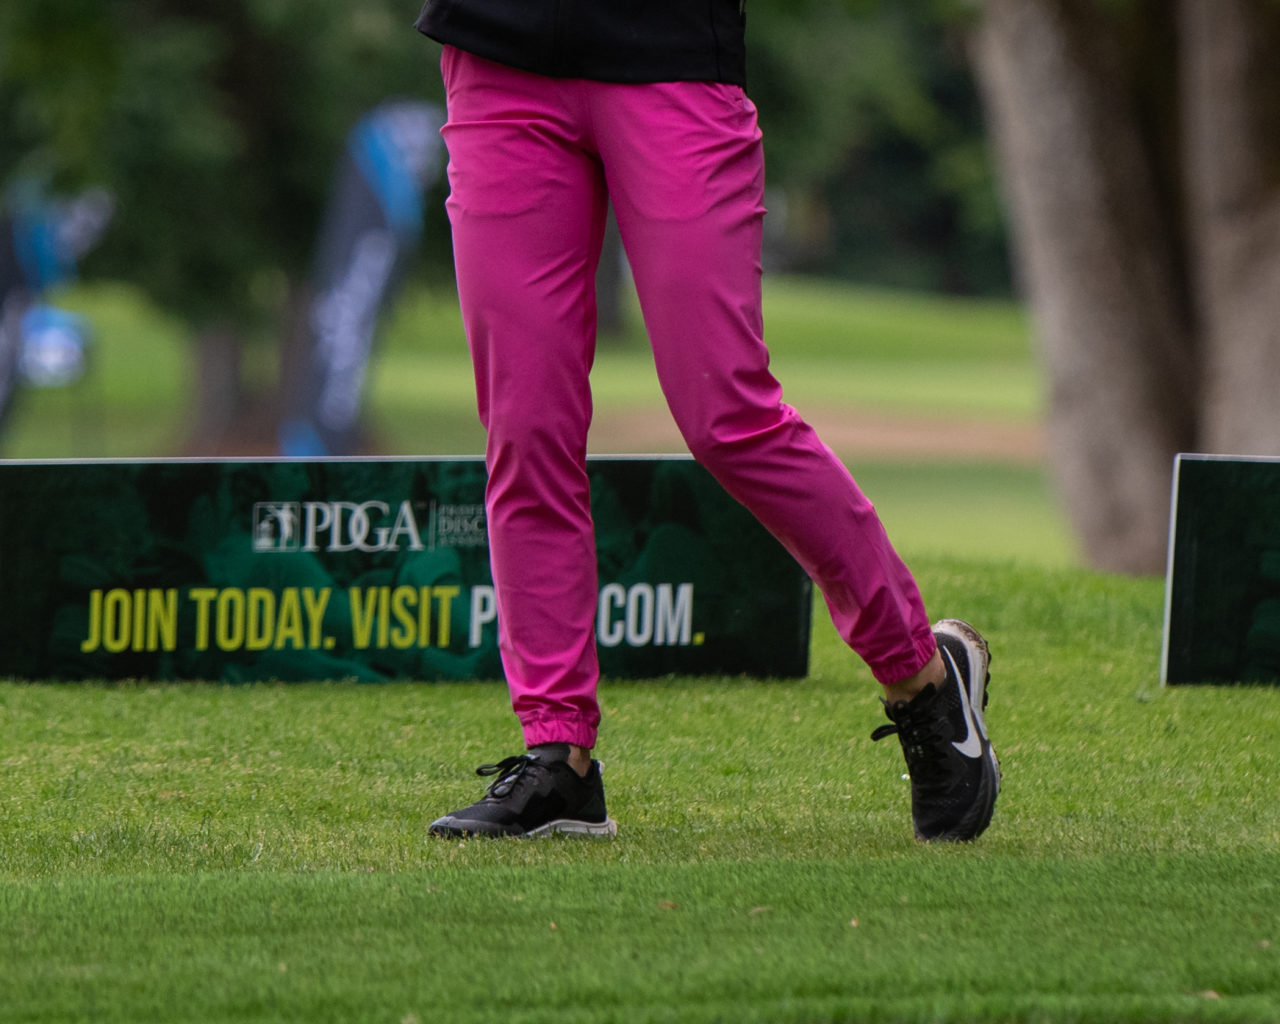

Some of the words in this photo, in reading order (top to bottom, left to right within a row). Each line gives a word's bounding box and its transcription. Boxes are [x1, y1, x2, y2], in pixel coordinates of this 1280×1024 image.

[302, 500, 425, 553] PDGA
[81, 587, 178, 653] JOIN
[189, 586, 336, 651] TODAY.
[349, 584, 460, 649] VISIT
